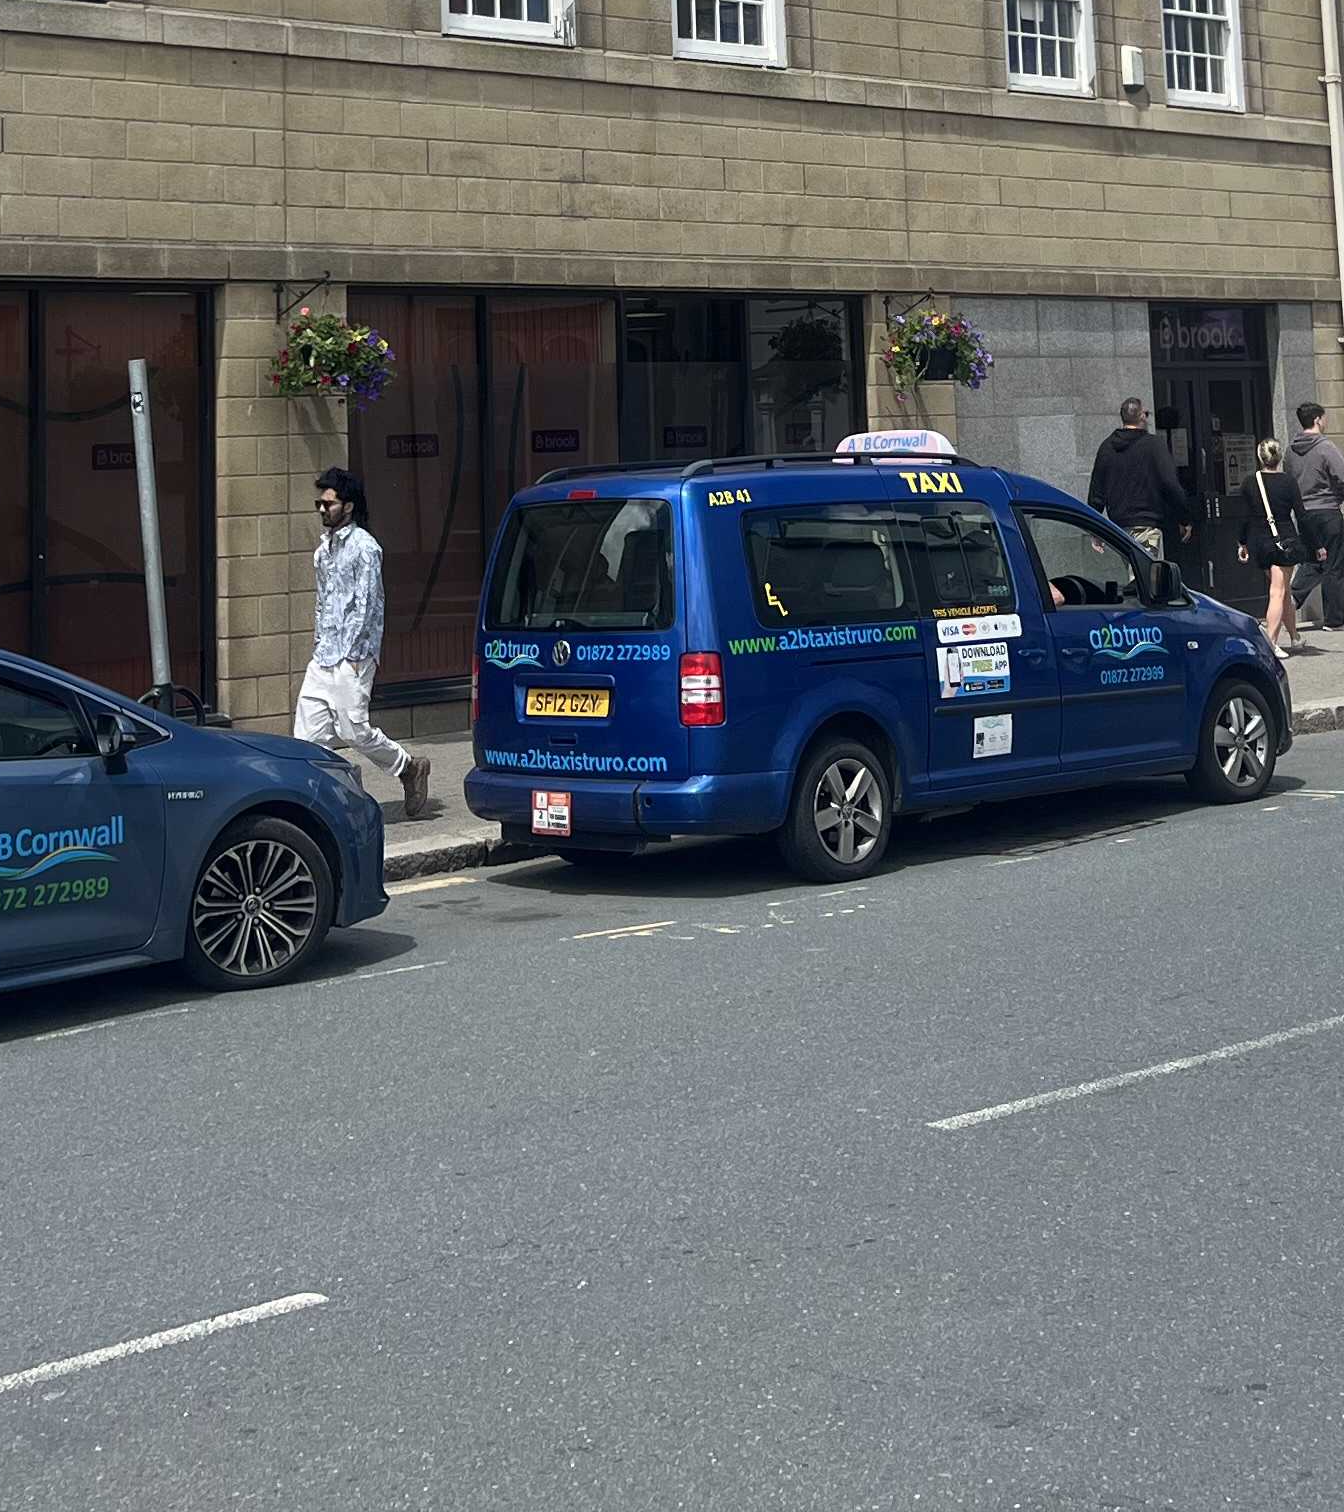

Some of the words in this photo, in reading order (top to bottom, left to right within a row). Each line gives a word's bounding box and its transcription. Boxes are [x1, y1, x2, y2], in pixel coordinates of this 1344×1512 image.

[1177, 318, 1233, 350] brook
[400, 439, 434, 455] brook
[545, 432, 577, 449] brook
[847, 437, 872, 453] AB
[899, 471, 964, 494] TAXI
[708, 490, 735, 507] A2B
[736, 488, 752, 503] 41
[728, 625, 918, 656] www.a2btaxistruro.com
[942, 625, 960, 637] VISA
[576, 645, 614, 661] 01872
[617, 644, 671, 661] 272989
[961, 644, 1006, 659] DOWNLOAD
[994, 660, 1008, 670] APP
[1100, 668, 1128, 685] 01872
[1129, 665, 1165, 682] 272989
[535, 692, 567, 713] SF12
[570, 693, 600, 713] GZY
[484, 749, 668, 772] www.a2btaxistruro.com
[15, 815, 124, 857] Cornwall
[33, 876, 110, 907] 272989
